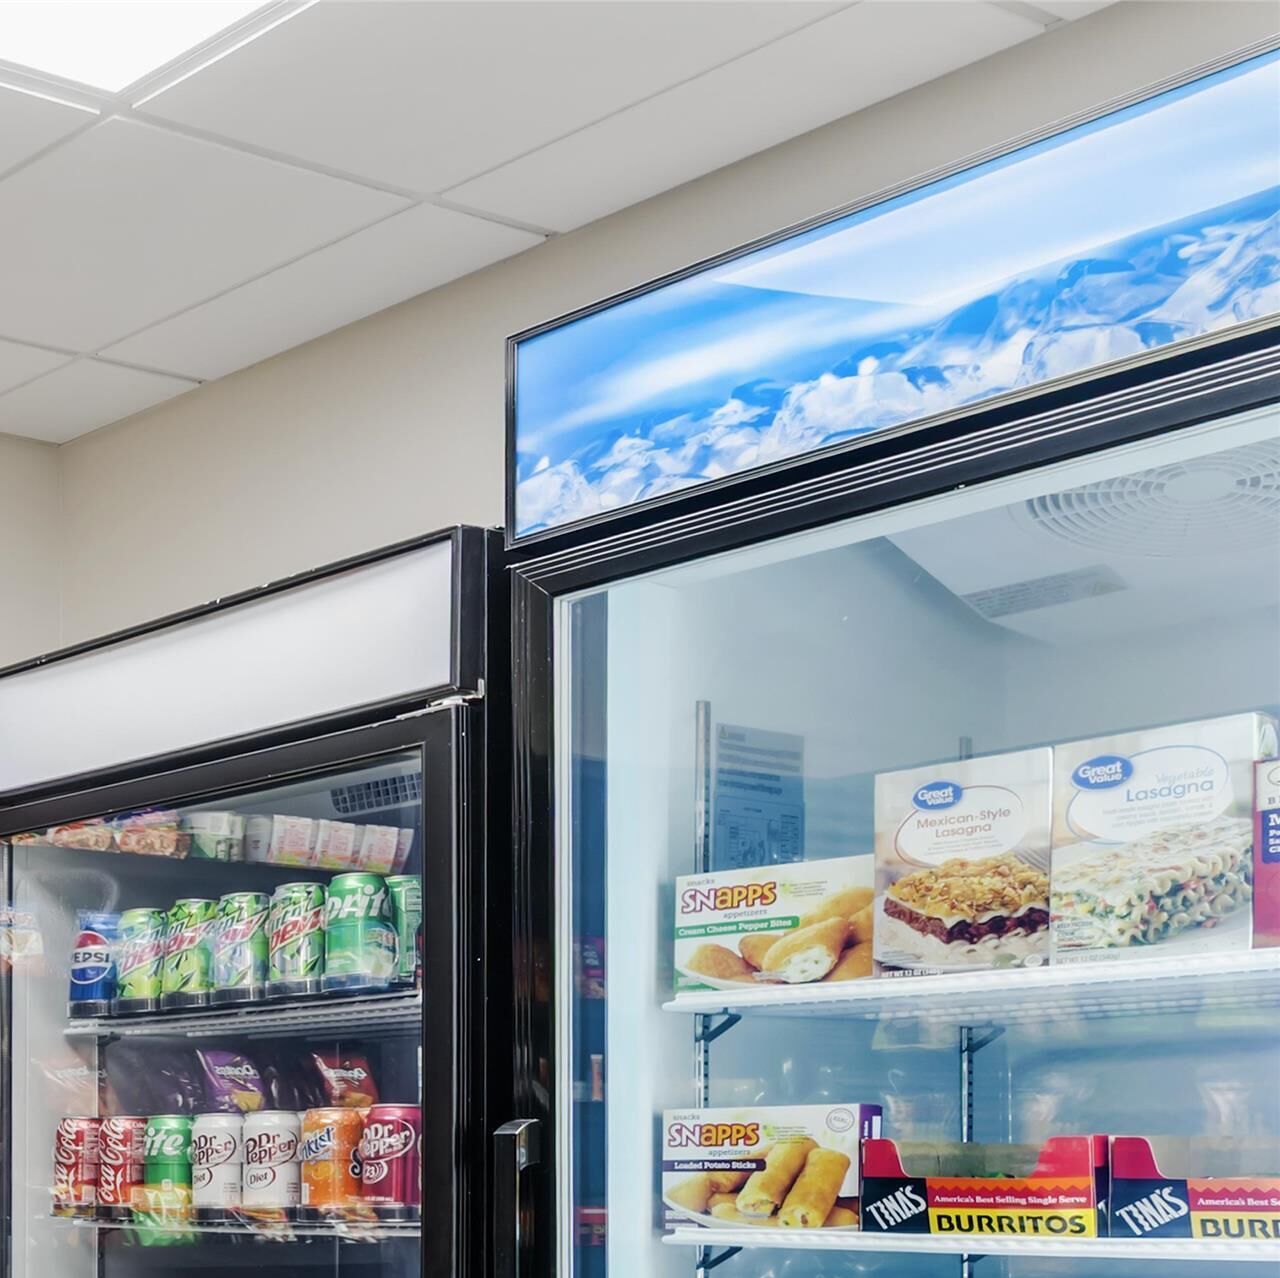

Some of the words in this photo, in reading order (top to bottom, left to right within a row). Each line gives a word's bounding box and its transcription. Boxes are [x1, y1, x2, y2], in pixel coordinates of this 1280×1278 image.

[1078, 760, 1123, 779] Great
[1155, 766, 1215, 784] Vegetable
[1089, 772, 1123, 784] Value
[917, 786, 954, 802] Great
[1126, 779, 1214, 803] Lasagna
[916, 807, 1011, 830] Mexican-Style
[935, 823, 992, 839] Lasagna
[723, 908, 768, 920] appetizers
[678, 927, 705, 936] Cream
[706, 923, 738, 934] Cheese
[738, 921, 769, 932] Pepper
[770, 918, 793, 928] Bites
[74, 952, 110, 963] EPSI
[257, 1131, 281, 1146] Dr
[369, 1123, 395, 1139] Dr
[144, 1127, 185, 1157] ite
[197, 1134, 218, 1148] Dr
[246, 1138, 296, 1165] Pepper
[708, 1149, 751, 1158] appetizers
[674, 1161, 703, 1170] Loaded
[703, 1161, 730, 1170] Potato
[731, 1161, 757, 1170] Sticks
[249, 1170, 269, 1184] Diet
[866, 1184, 928, 1232] TINA'S
[933, 1194, 974, 1204] America's
[975, 1195, 994, 1204] Best
[995, 1194, 1026, 1206] Selling
[1027, 1194, 1057, 1206] Single
[1058, 1194, 1088, 1204] Serve
[1197, 1197, 1242, 1207] America's
[1243, 1197, 1266, 1207] Best
[1114, 1186, 1189, 1236] TINA'S
[936, 1213, 1087, 1235] BURRITOS
